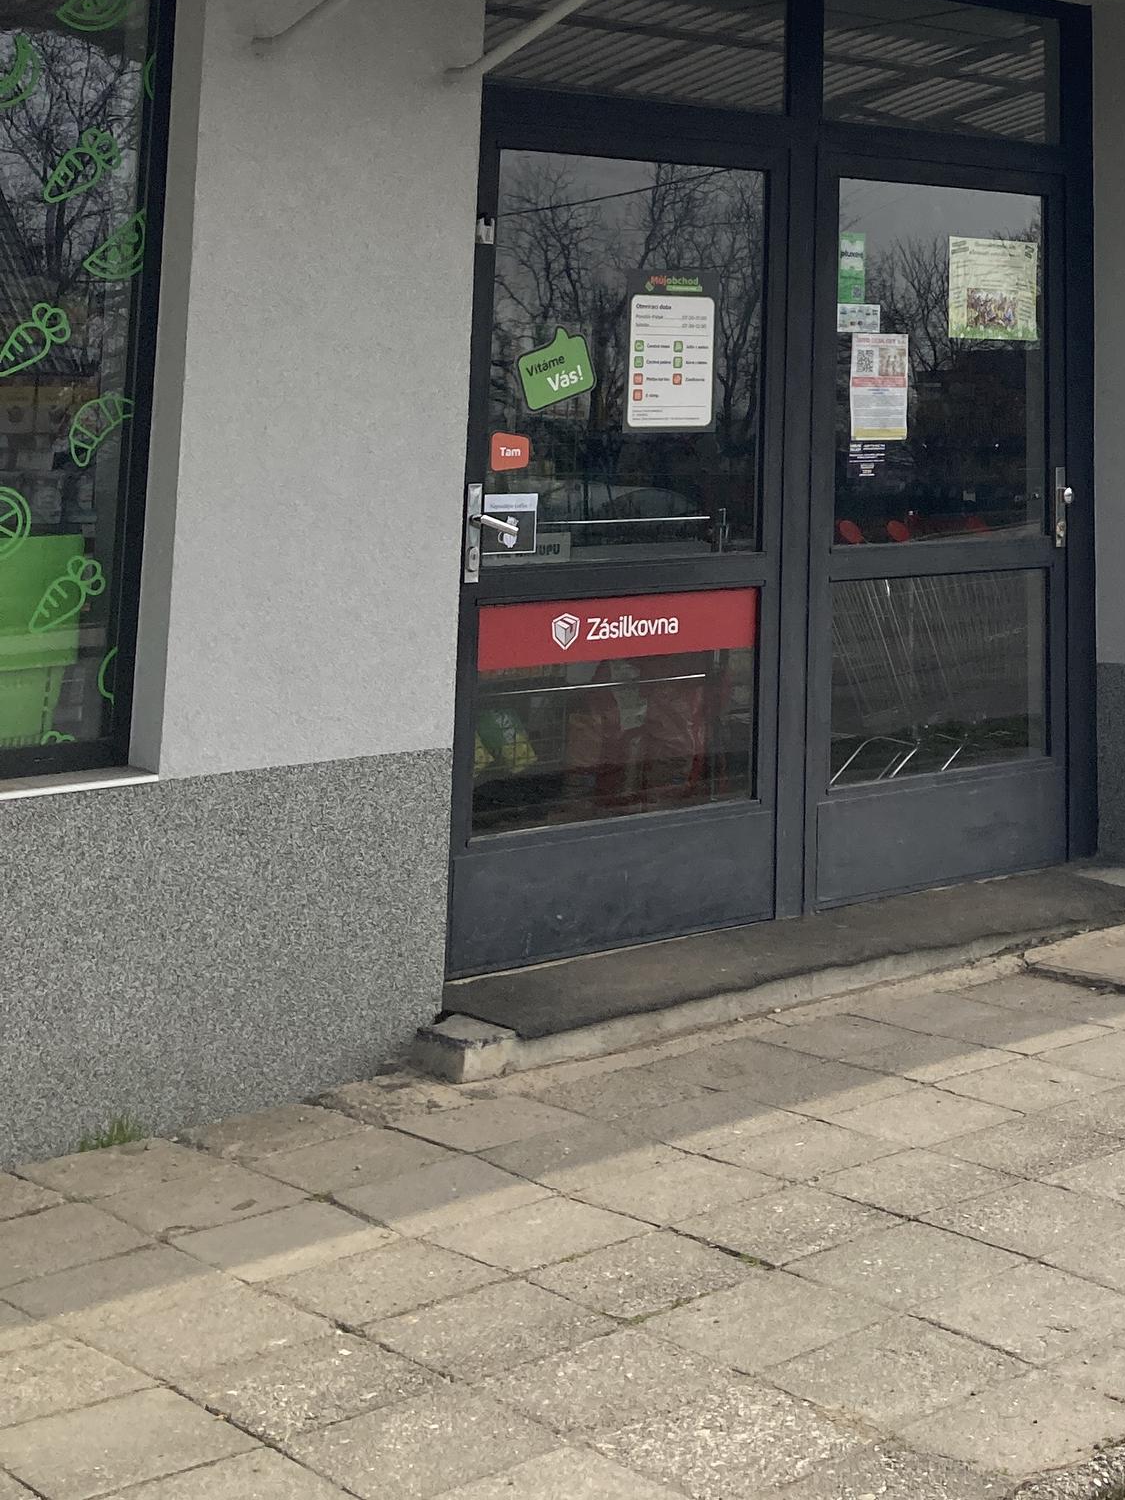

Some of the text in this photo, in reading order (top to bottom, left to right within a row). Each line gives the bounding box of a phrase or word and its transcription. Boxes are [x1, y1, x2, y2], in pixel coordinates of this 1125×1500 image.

[547, 365, 583, 391] Vás!
[500, 446, 521, 457] Tam
[586, 615, 679, 641] Zásilkovna
